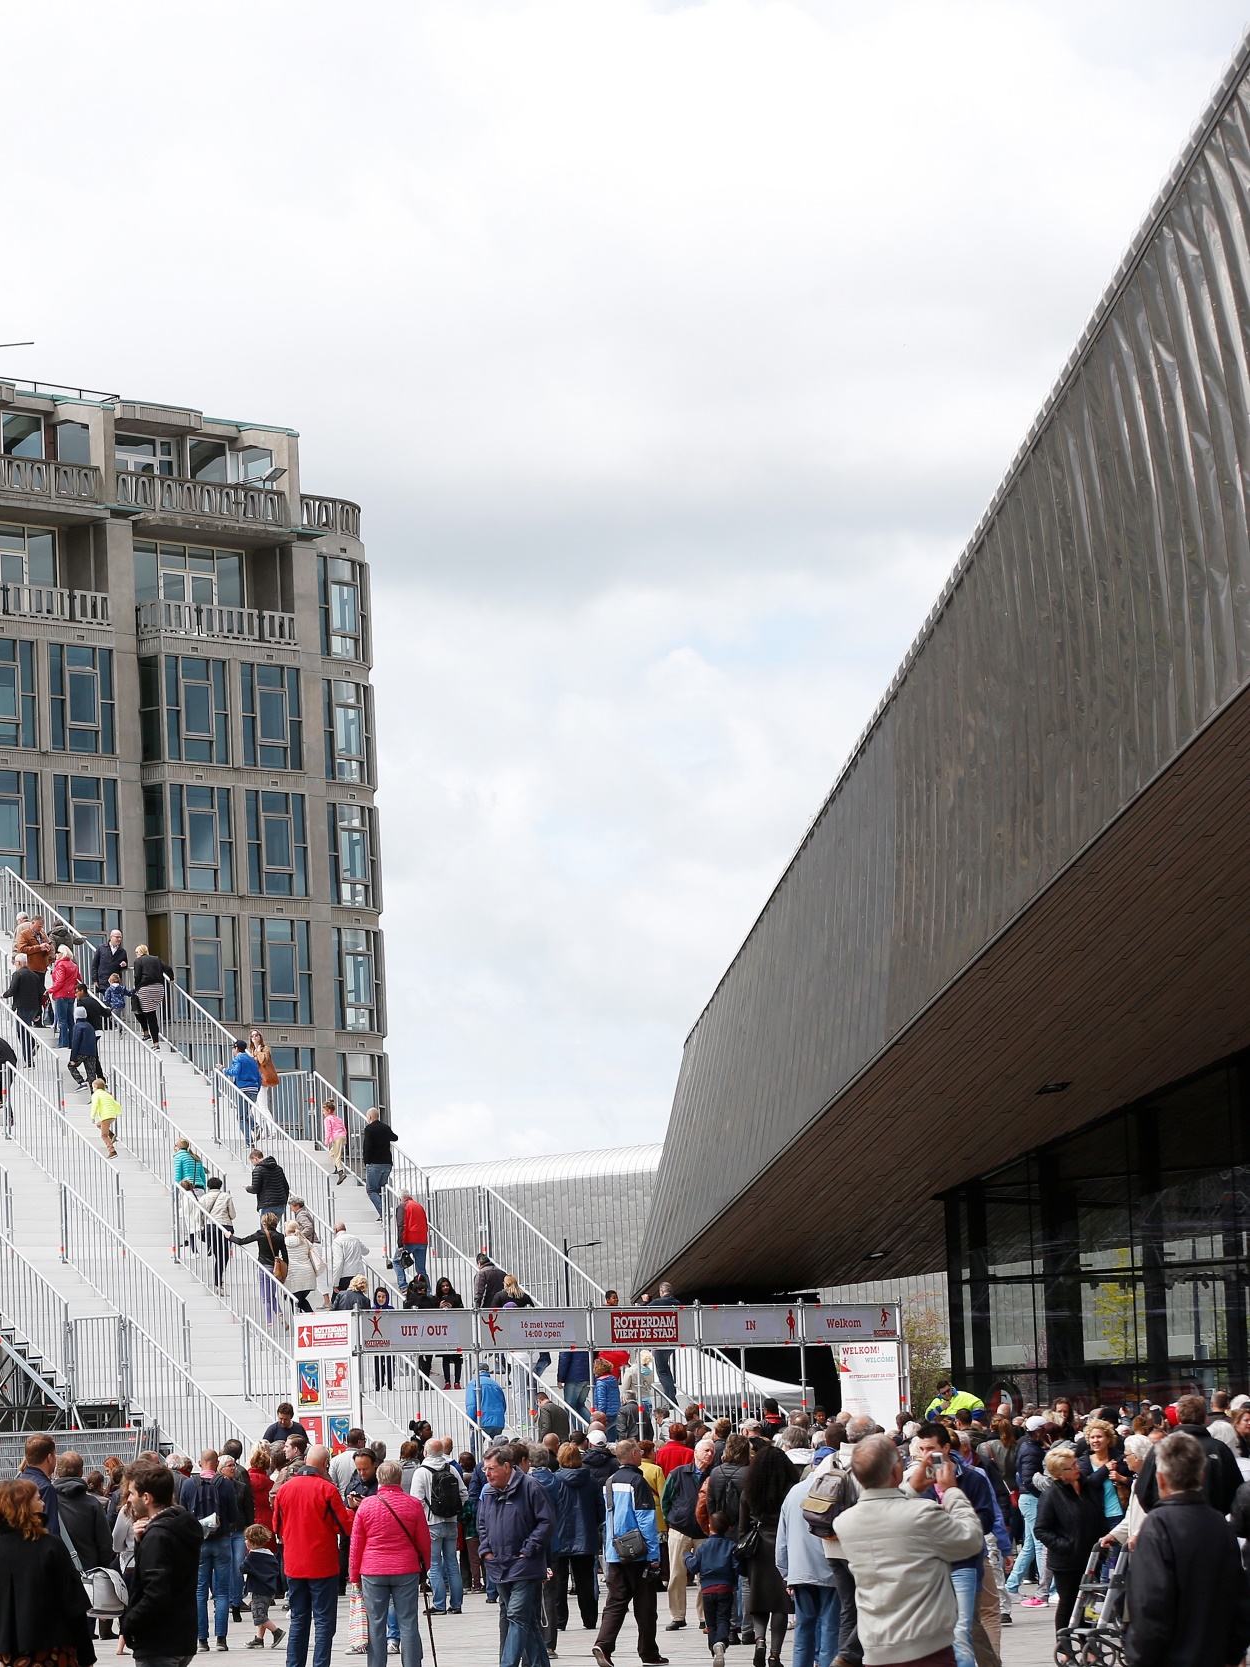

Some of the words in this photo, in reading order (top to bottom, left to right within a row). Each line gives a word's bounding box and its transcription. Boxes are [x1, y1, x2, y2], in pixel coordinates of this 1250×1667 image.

[520, 1321, 529, 1329] 16
[544, 1320, 565, 1328] vanaf
[613, 1316, 676, 1328] ROTTERDAM
[745, 1320, 756, 1331] IN
[825, 1318, 862, 1328] Welkom
[401, 1325, 419, 1336] UIT
[427, 1325, 448, 1336] OUT
[524, 1330, 542, 1338] 14:00
[543, 1330, 562, 1339] open
[614, 1329, 638, 1339] VIERT
[640, 1329, 652, 1339] DE
[653, 1328, 677, 1339] STAD!
[842, 1346, 880, 1355] WELKOM!
